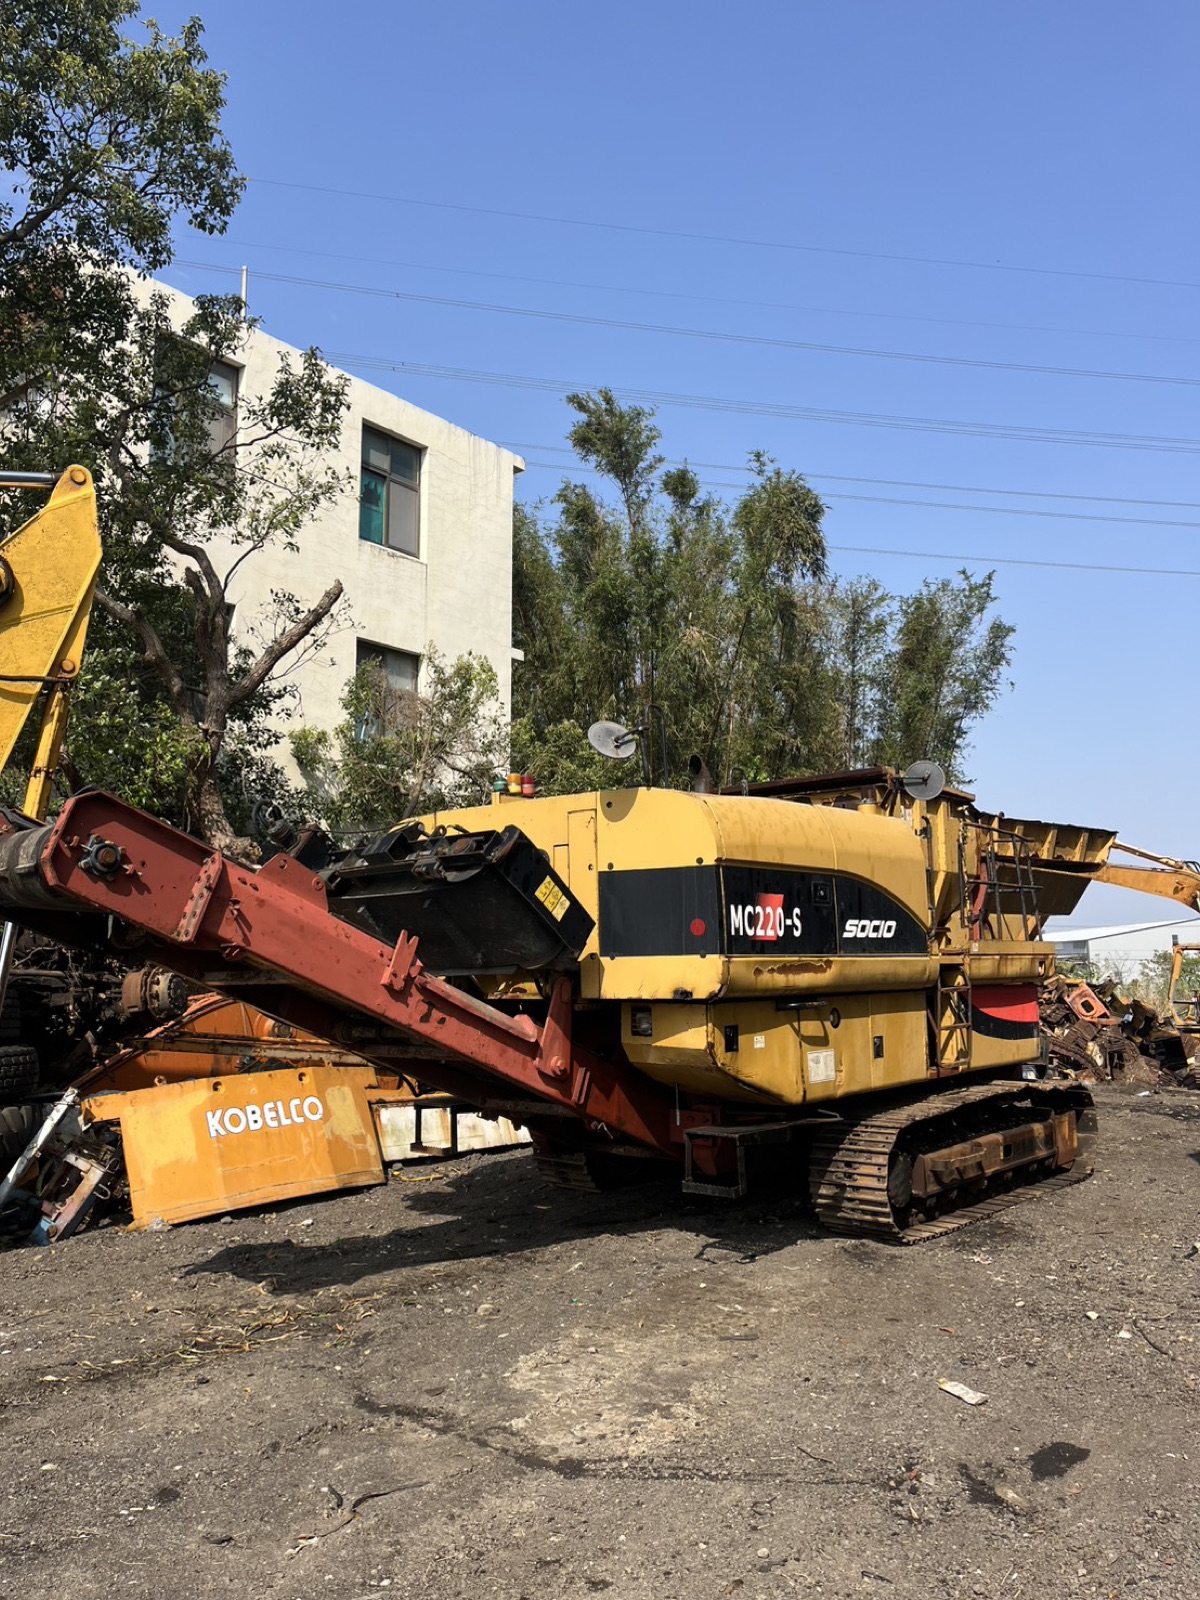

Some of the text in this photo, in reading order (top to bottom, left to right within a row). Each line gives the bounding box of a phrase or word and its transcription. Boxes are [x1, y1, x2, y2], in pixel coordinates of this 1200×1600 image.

[730, 904, 801, 938] MC220-S
[842, 919, 897, 939] SOCIO
[206, 1095, 324, 1138] KOBELCO
